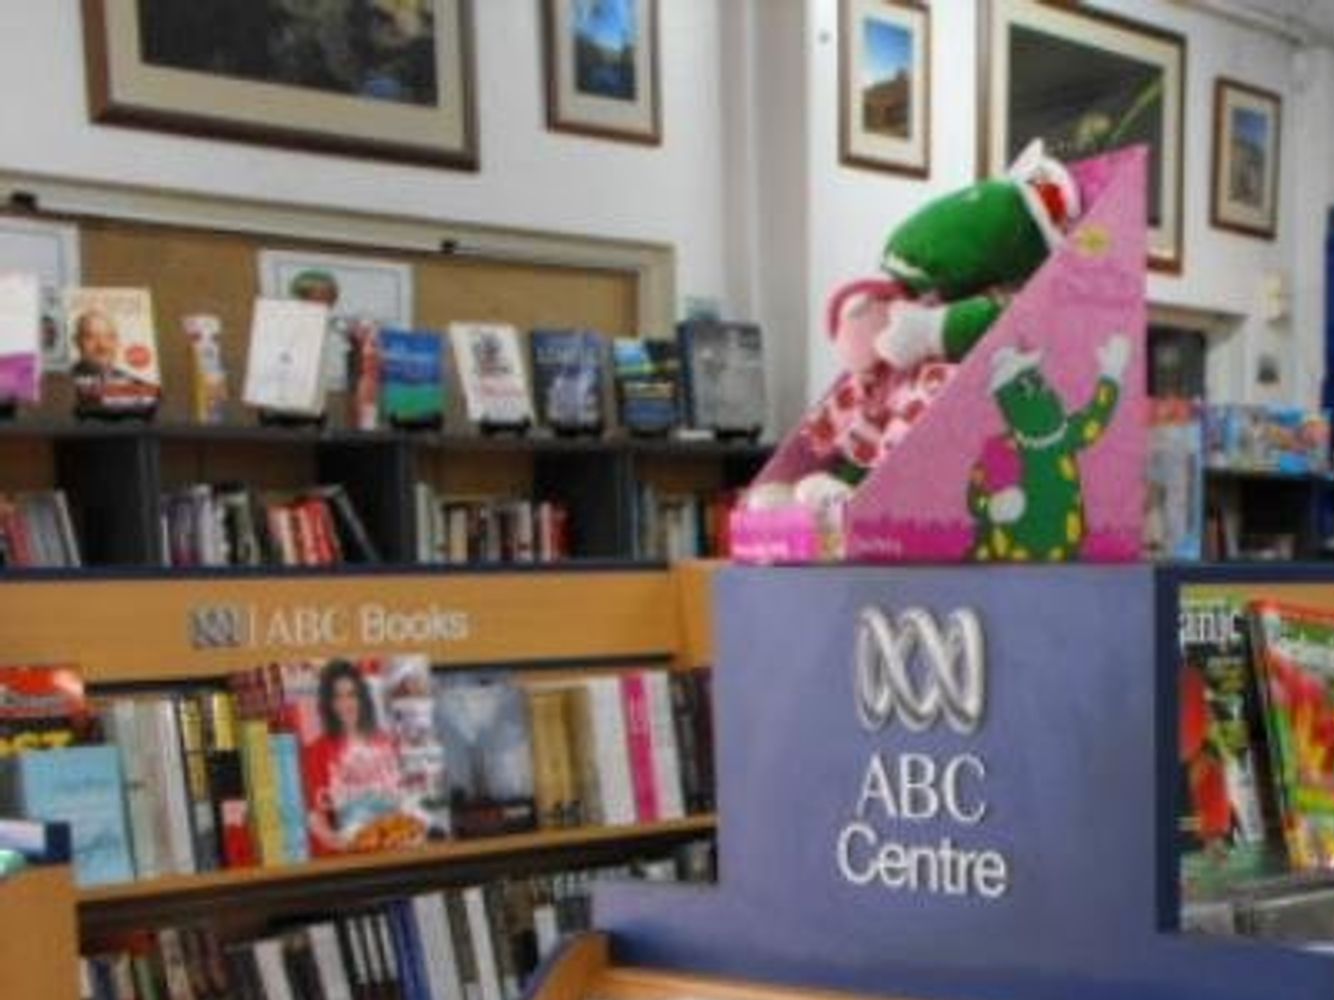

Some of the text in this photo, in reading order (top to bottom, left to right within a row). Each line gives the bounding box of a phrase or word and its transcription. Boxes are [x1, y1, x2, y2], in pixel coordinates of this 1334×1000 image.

[267, 601, 469, 648] ABC Books
[857, 752, 987, 823] ABC
[837, 822, 1007, 898] Centre
